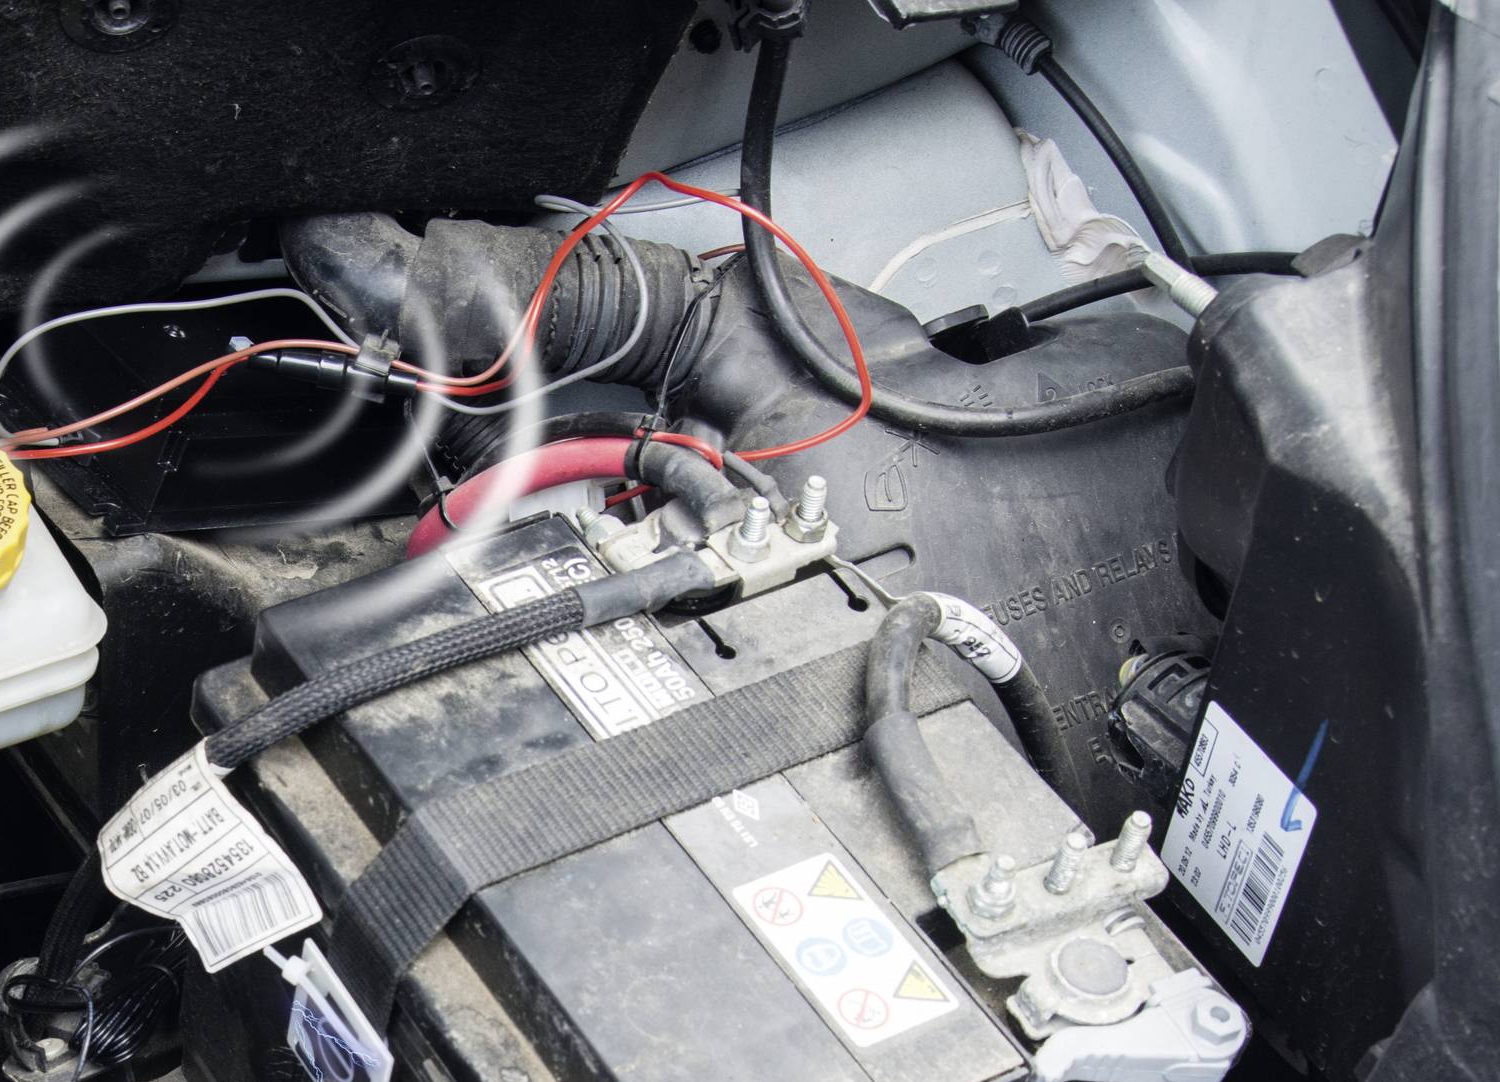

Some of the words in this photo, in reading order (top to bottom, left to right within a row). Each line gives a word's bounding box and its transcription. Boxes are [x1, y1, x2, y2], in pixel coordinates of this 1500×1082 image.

[5, 493, 19, 515] CAP
[1048, 567, 1093, 605] AND
[1094, 538, 1172, 588] RELAYS
[612, 614, 654, 652] 250
[642, 649, 696, 701] 50Ah
[138, 779, 187, 822] 03/05/07
[1215, 820, 1237, 859] LHD-L
[153, 882, 182, 903] 225
